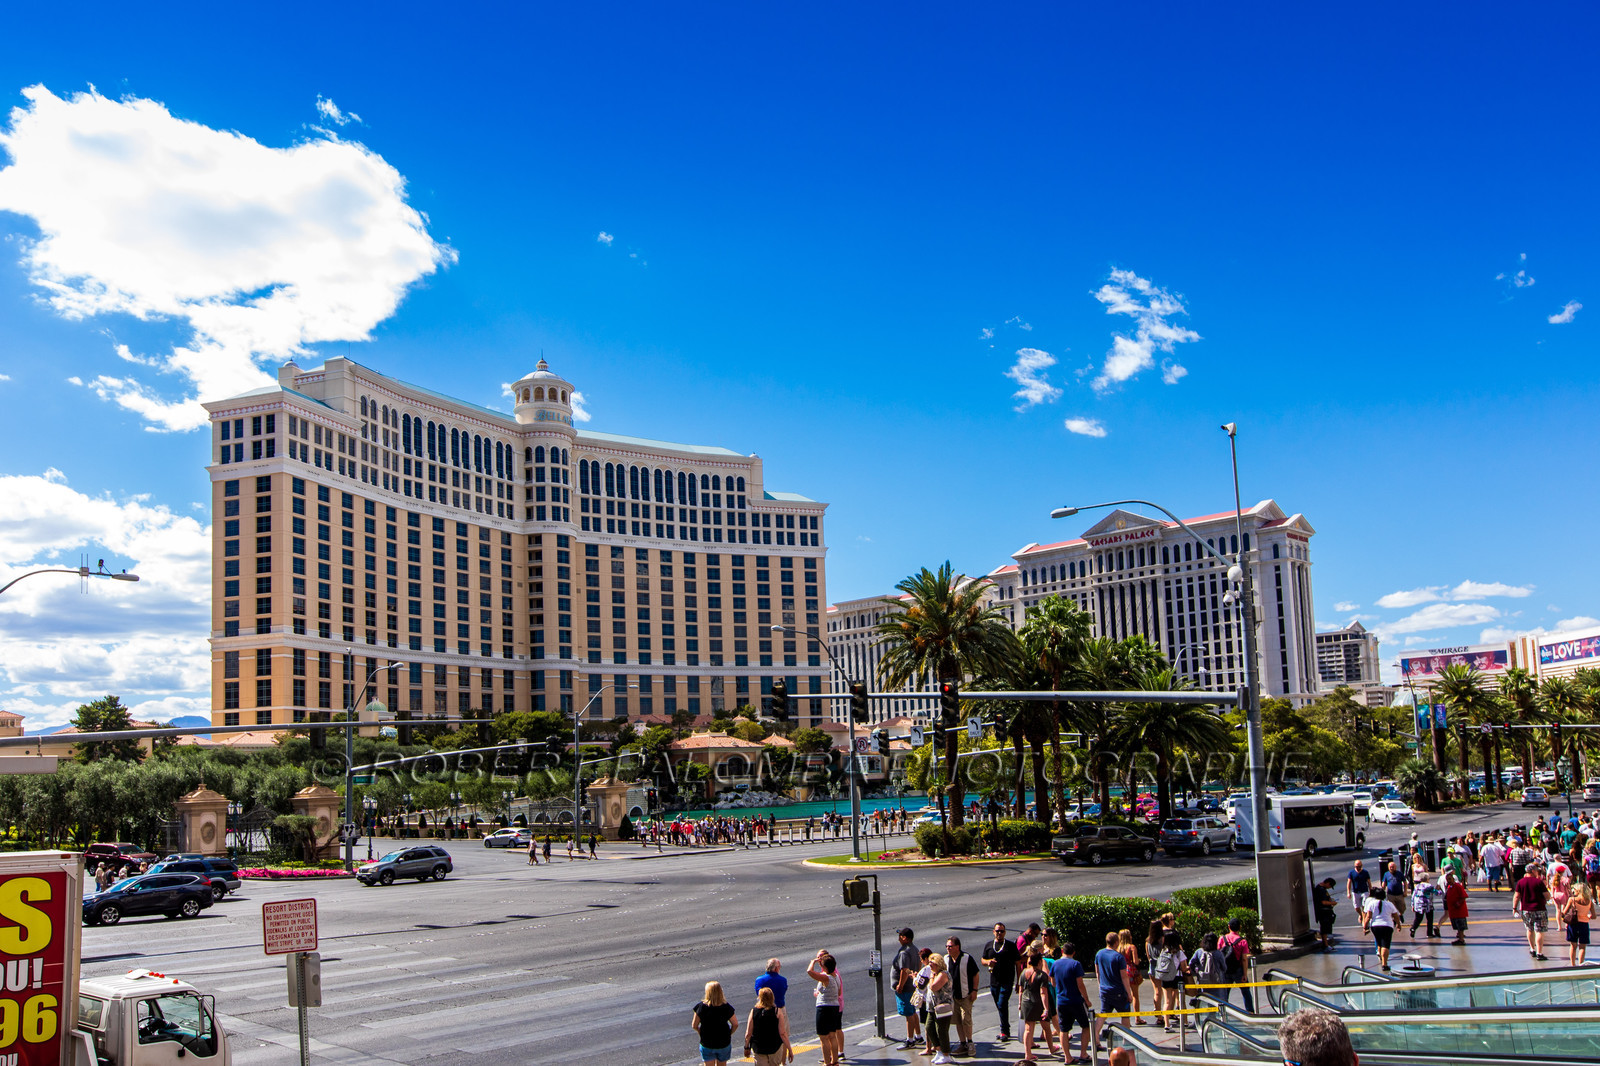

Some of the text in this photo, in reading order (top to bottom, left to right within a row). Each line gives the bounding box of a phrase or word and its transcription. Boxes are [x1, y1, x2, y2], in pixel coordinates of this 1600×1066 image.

[1090, 529, 1155, 547] CAESARS PALACE
[1438, 646, 1469, 654] MIRAGE
[1552, 640, 1582, 660] LOVE
[266, 904, 286, 914] RESORT
[273, 912, 301, 920] OBSTRUCTIVE
[268, 932, 300, 940] DESIGNATED
